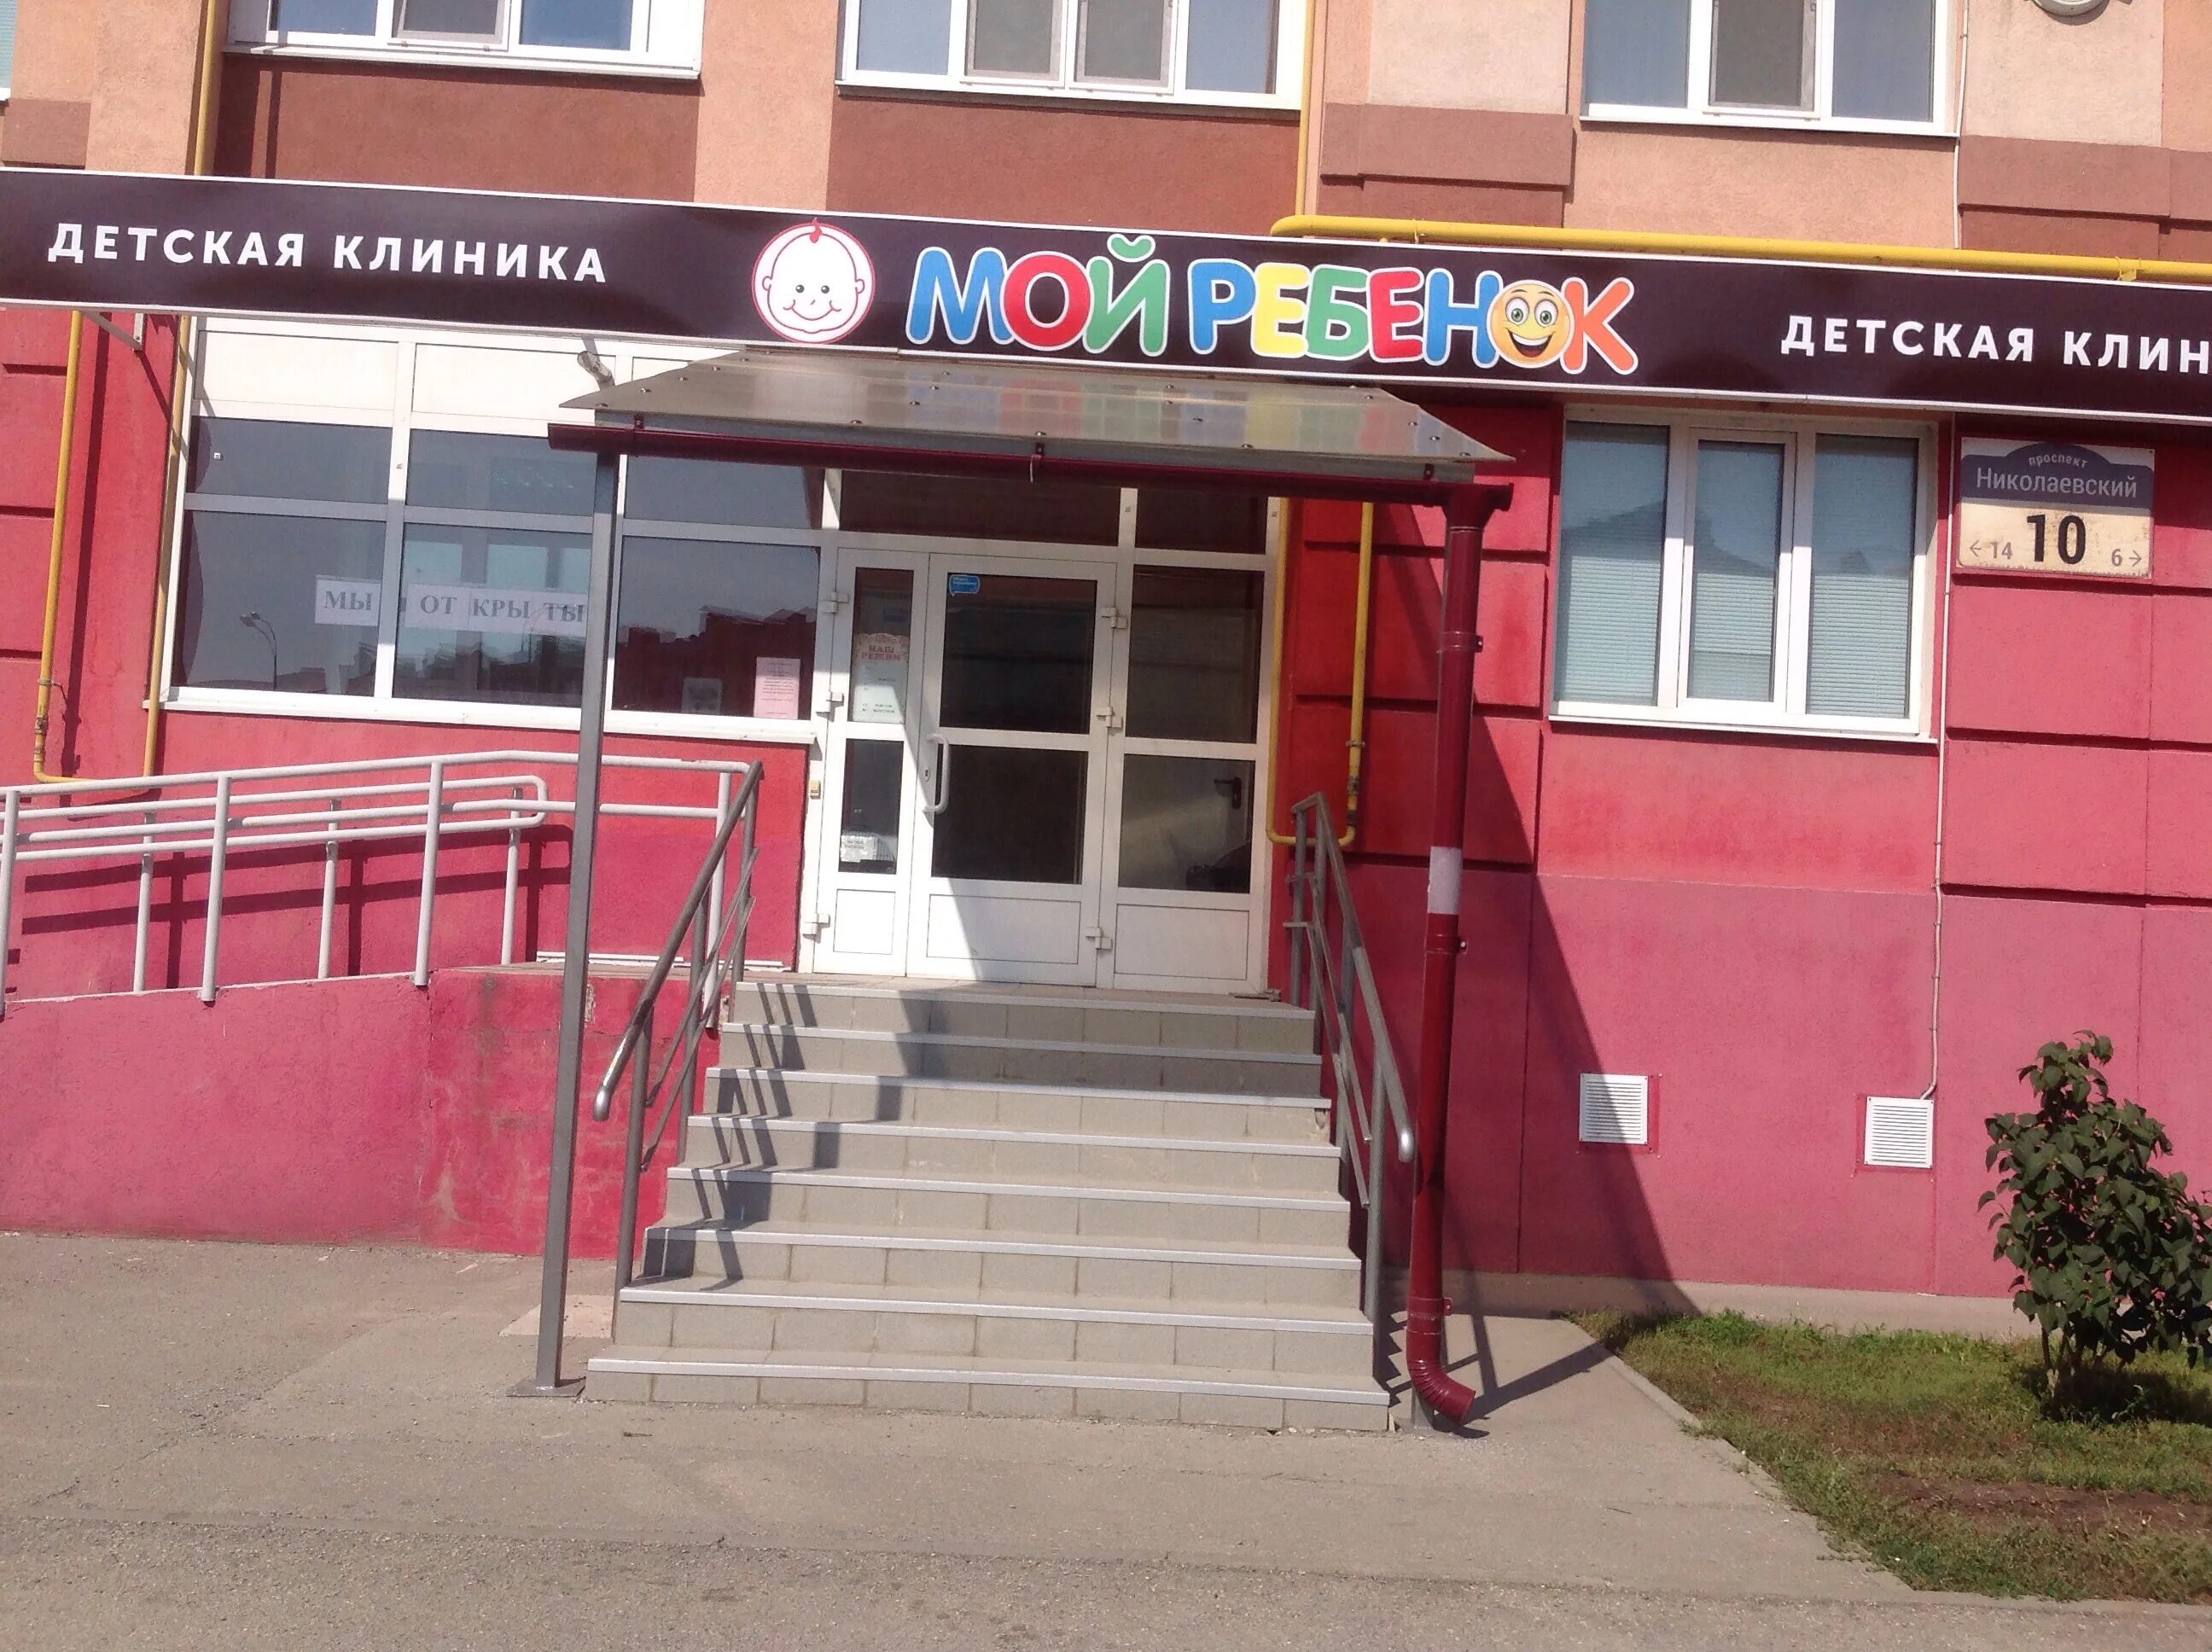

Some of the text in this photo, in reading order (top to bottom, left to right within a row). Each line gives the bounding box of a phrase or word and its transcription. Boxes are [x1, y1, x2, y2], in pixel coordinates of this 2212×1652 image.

[48, 223, 607, 283] ДЕТСКАЯ КЛИНИКА
[905, 233, 1171, 357] МОЙ
[1780, 315, 2209, 375] ДЕТСКАЯ КЛИН
[1976, 467, 2138, 498] Николаевский
[2028, 453, 2089, 468] проспект
[1989, 514, 2123, 567] 14 10 6
[323, 590, 373, 611] МЫ
